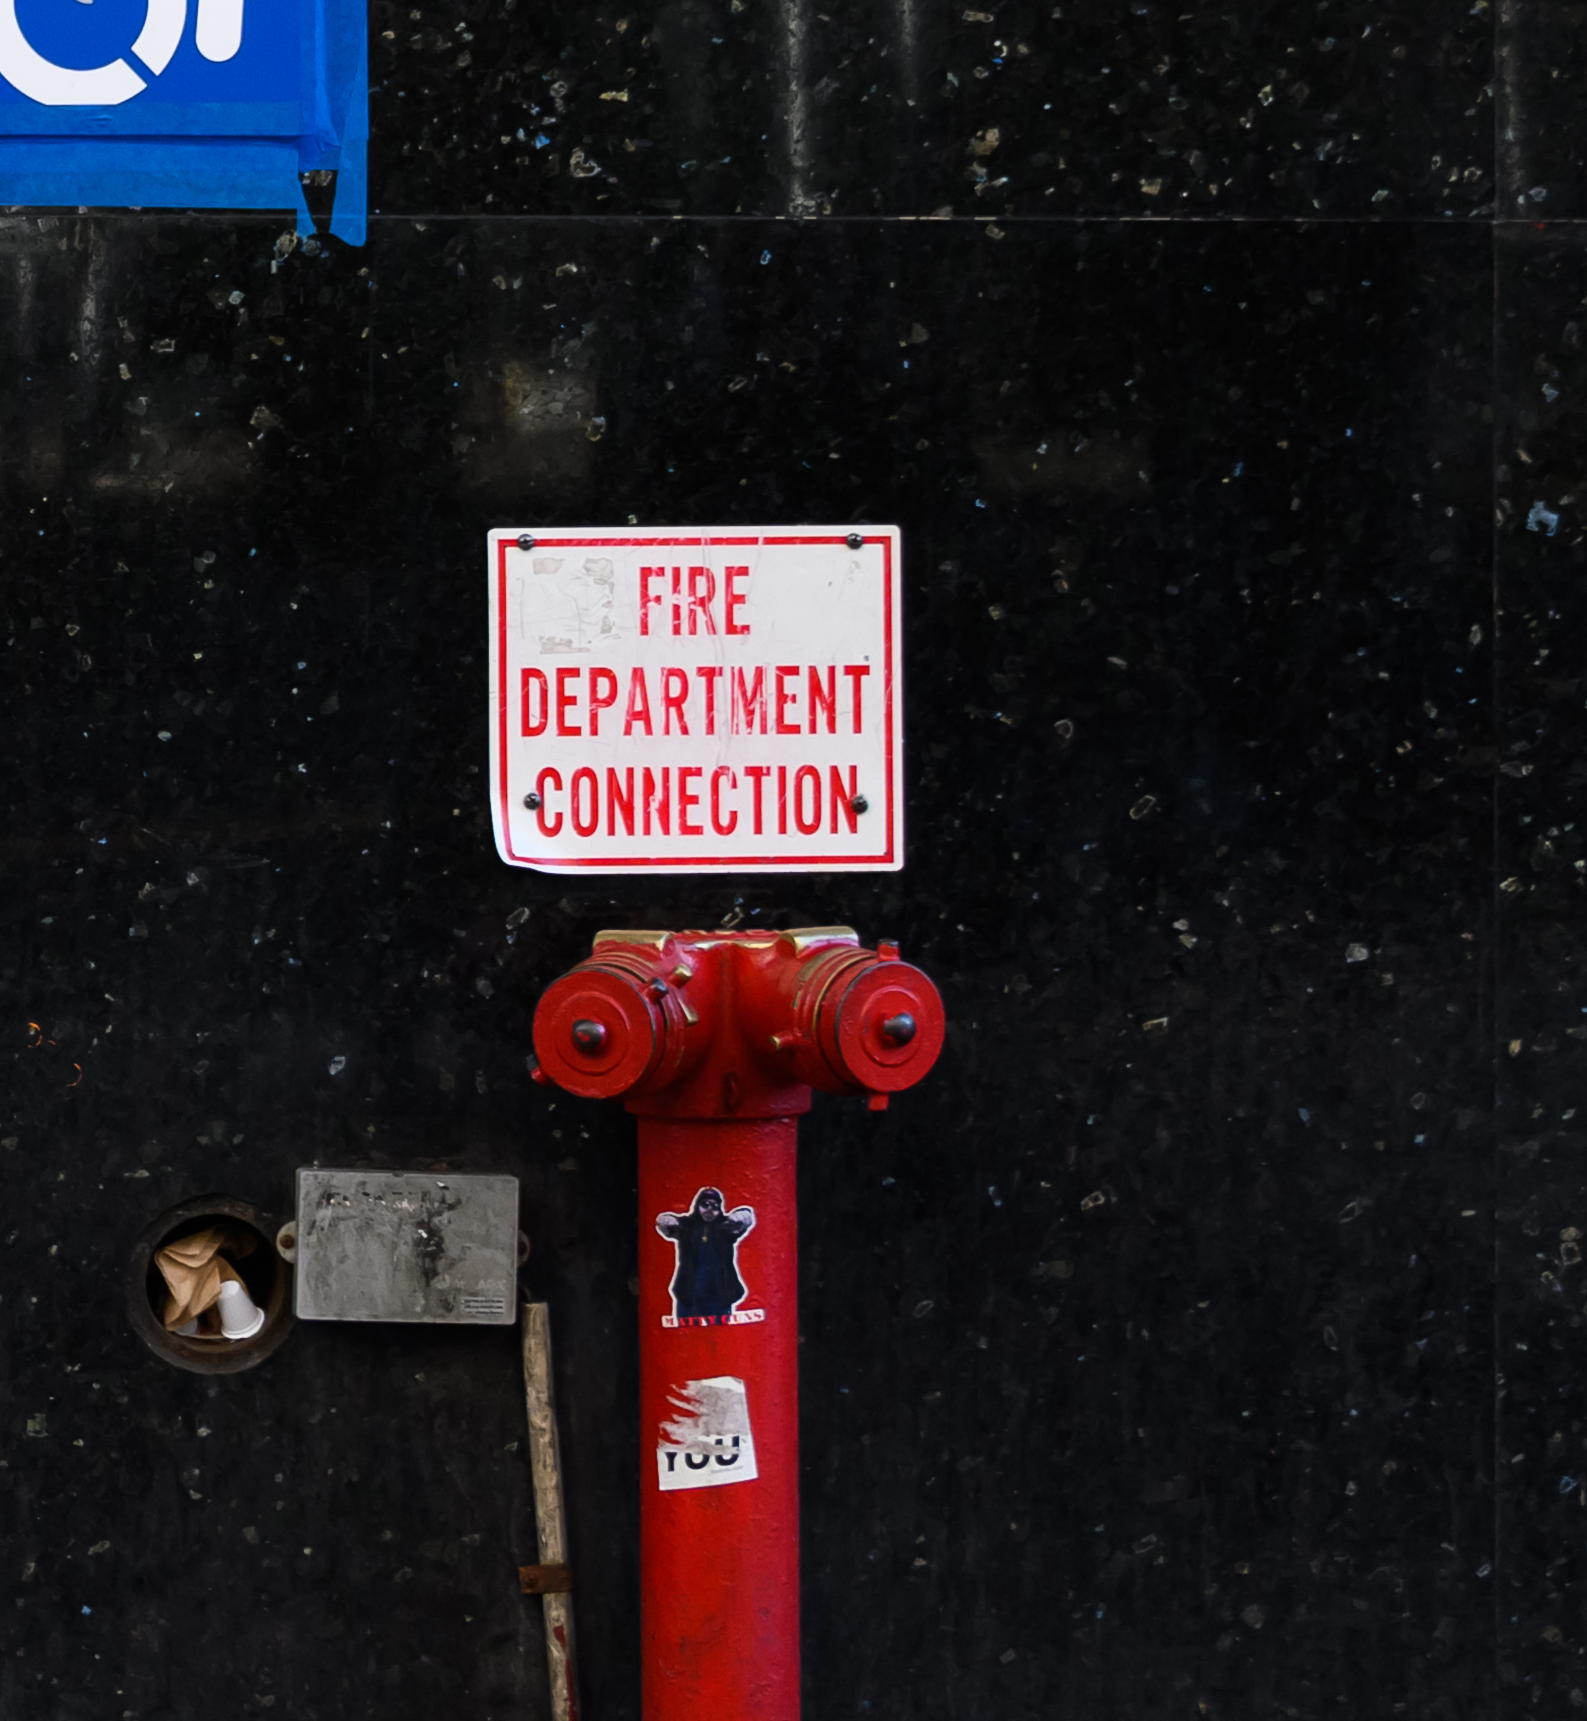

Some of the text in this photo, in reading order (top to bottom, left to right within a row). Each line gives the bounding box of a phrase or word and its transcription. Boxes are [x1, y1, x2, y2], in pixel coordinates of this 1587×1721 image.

[640, 566, 750, 635] FIRE
[521, 665, 870, 736] DEPARTMENT
[536, 765, 858, 837] CONNECTION
